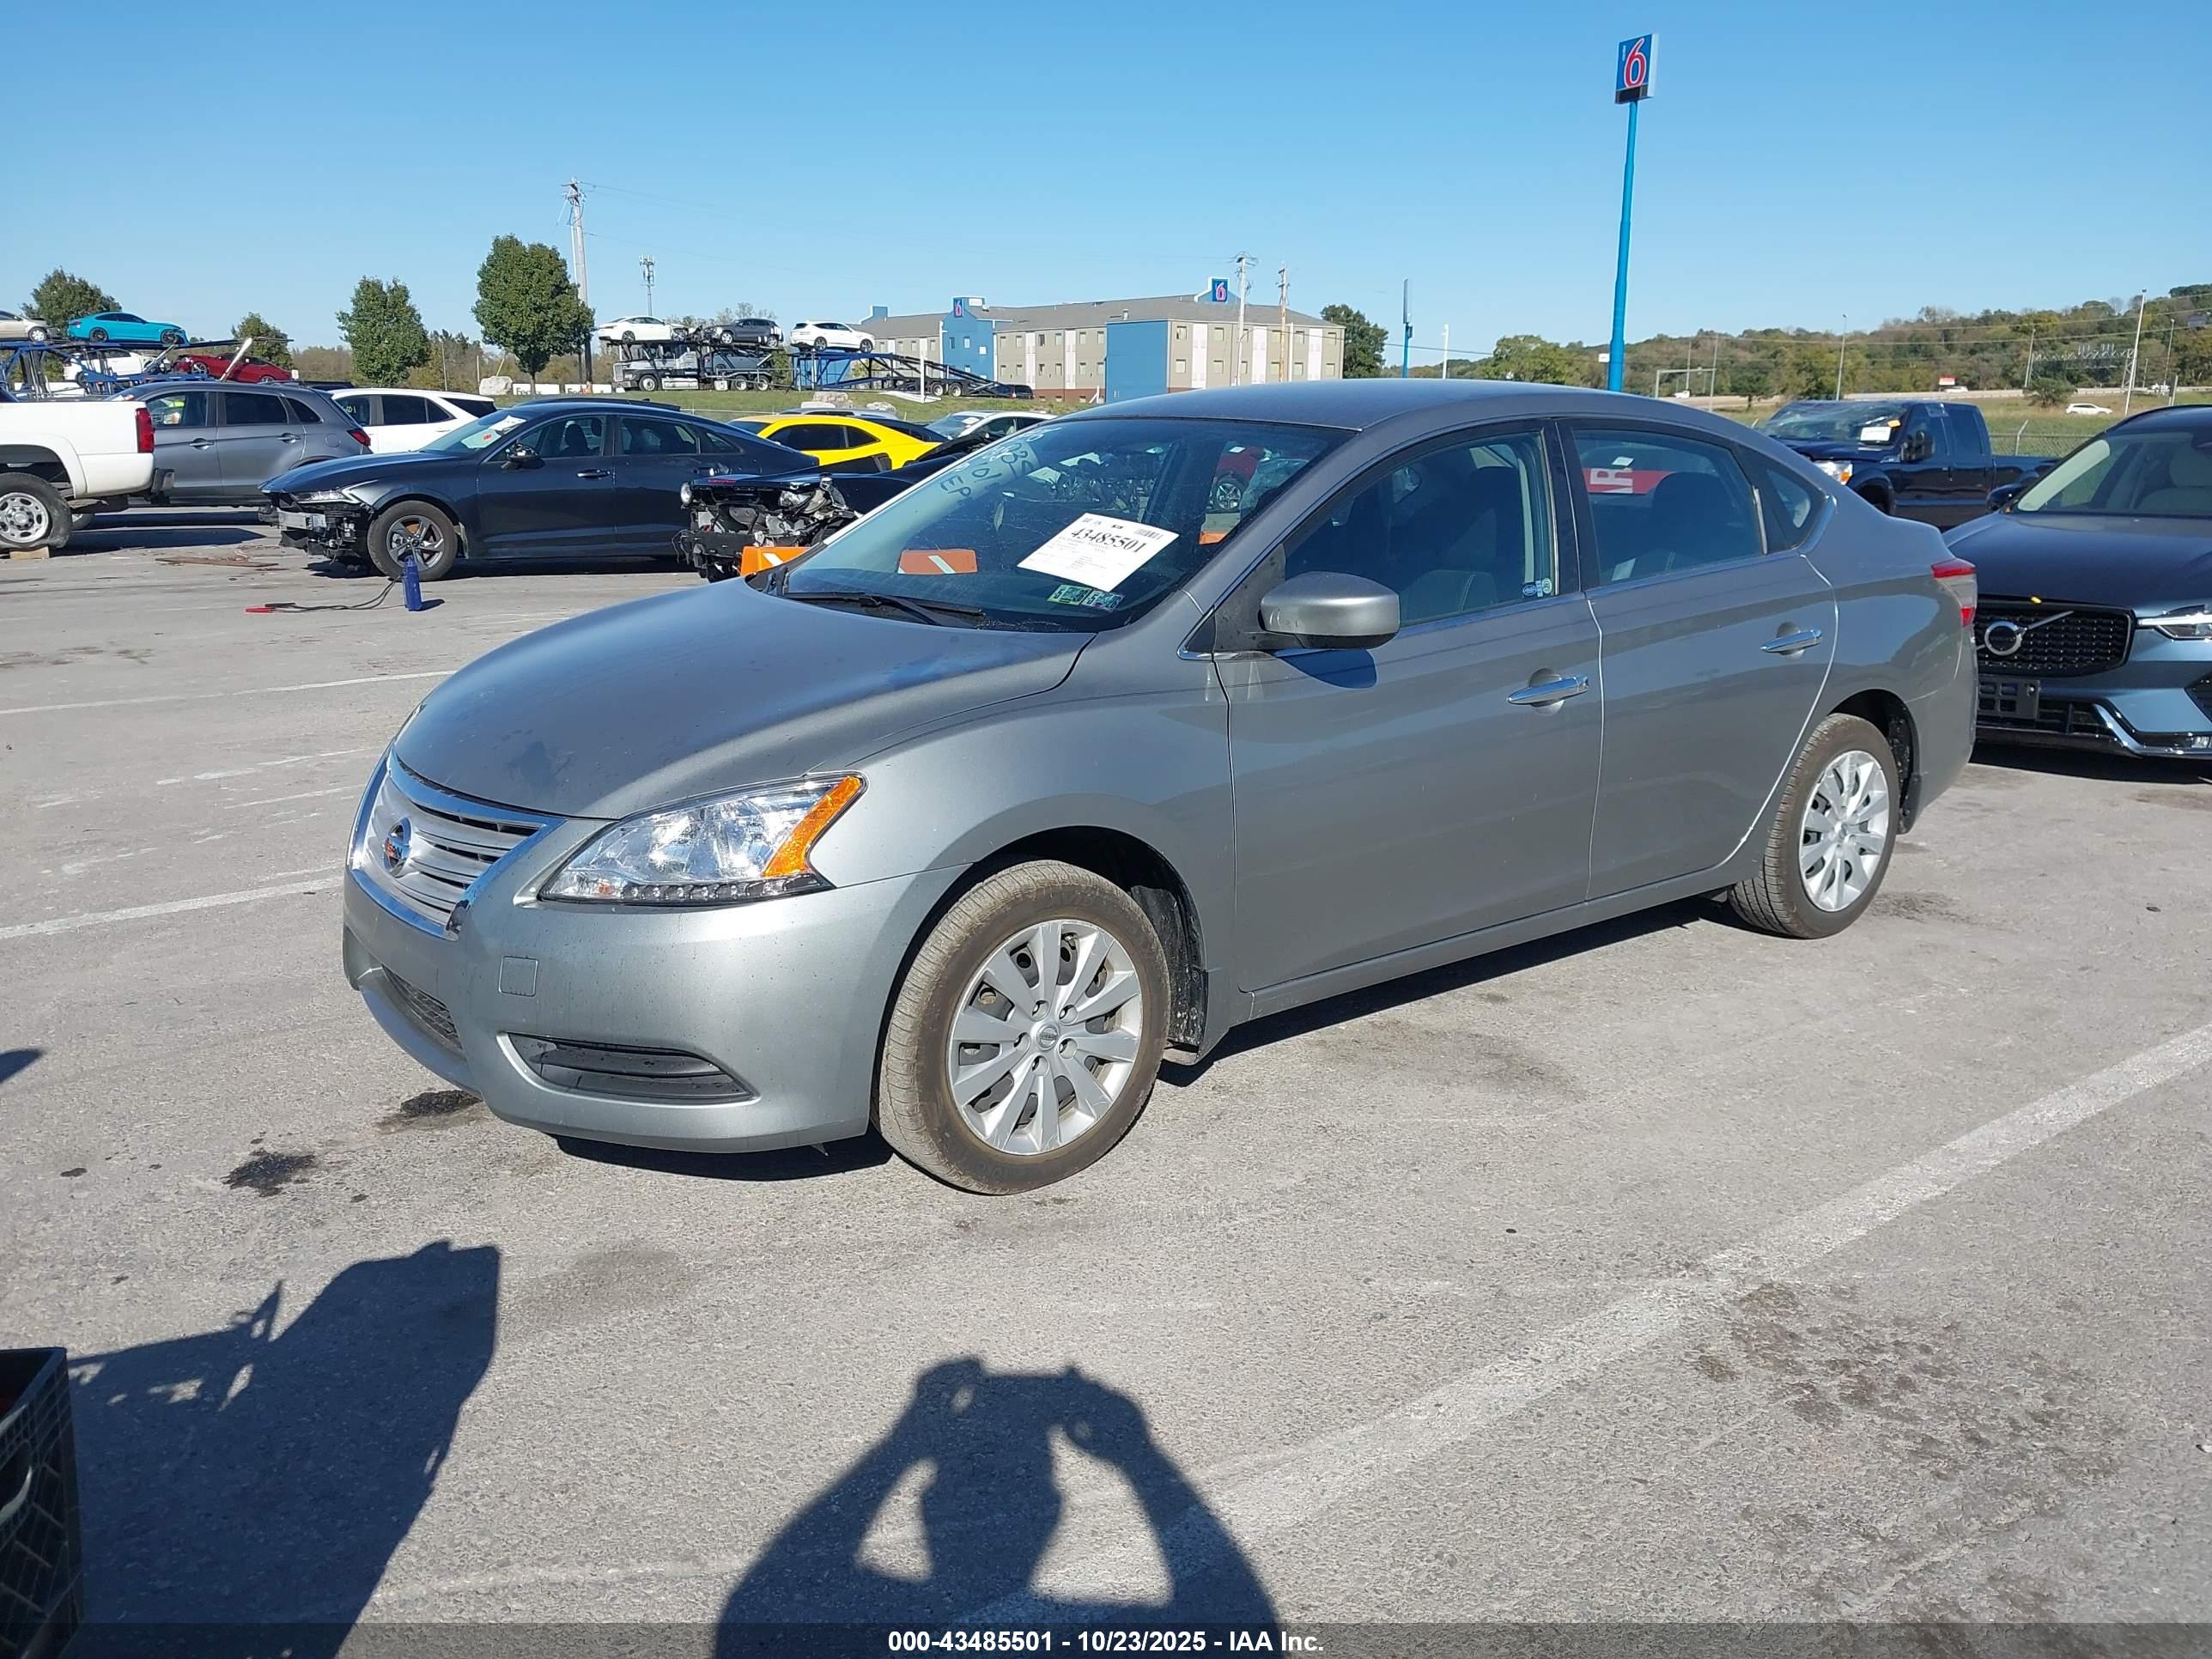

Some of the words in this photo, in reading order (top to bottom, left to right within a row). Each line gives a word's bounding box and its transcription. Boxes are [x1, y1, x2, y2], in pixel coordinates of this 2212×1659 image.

[1624, 38, 1646, 88] 6
[1215, 282, 1226, 301] 6
[955, 300, 962, 317] 6
[1072, 527, 1147, 553] 43485501
